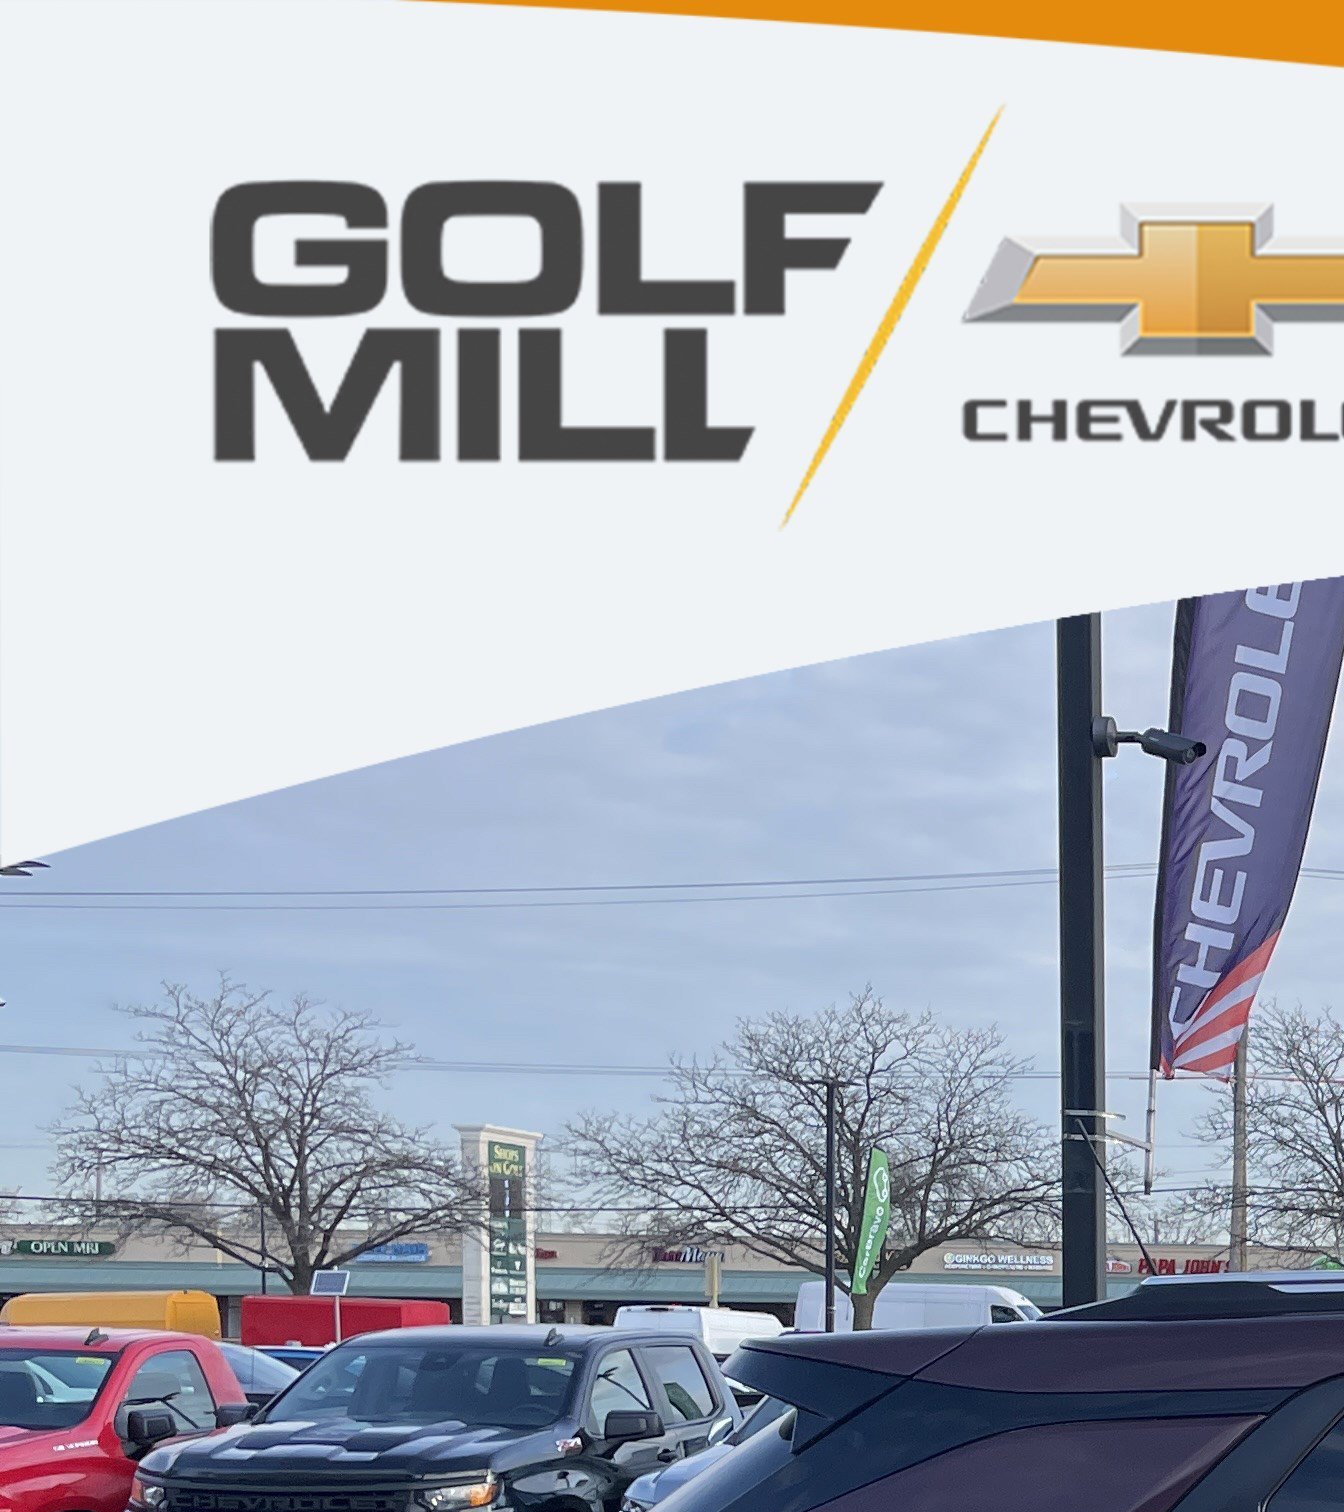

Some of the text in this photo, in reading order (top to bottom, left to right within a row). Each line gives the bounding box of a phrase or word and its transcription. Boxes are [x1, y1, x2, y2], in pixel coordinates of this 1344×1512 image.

[30, 1240, 69, 1254] OPEN
[72, 1241, 100, 1255] MRI
[997, 1255, 1054, 1265] WELLNESS
[1138, 1258, 1176, 1275] PAPA
